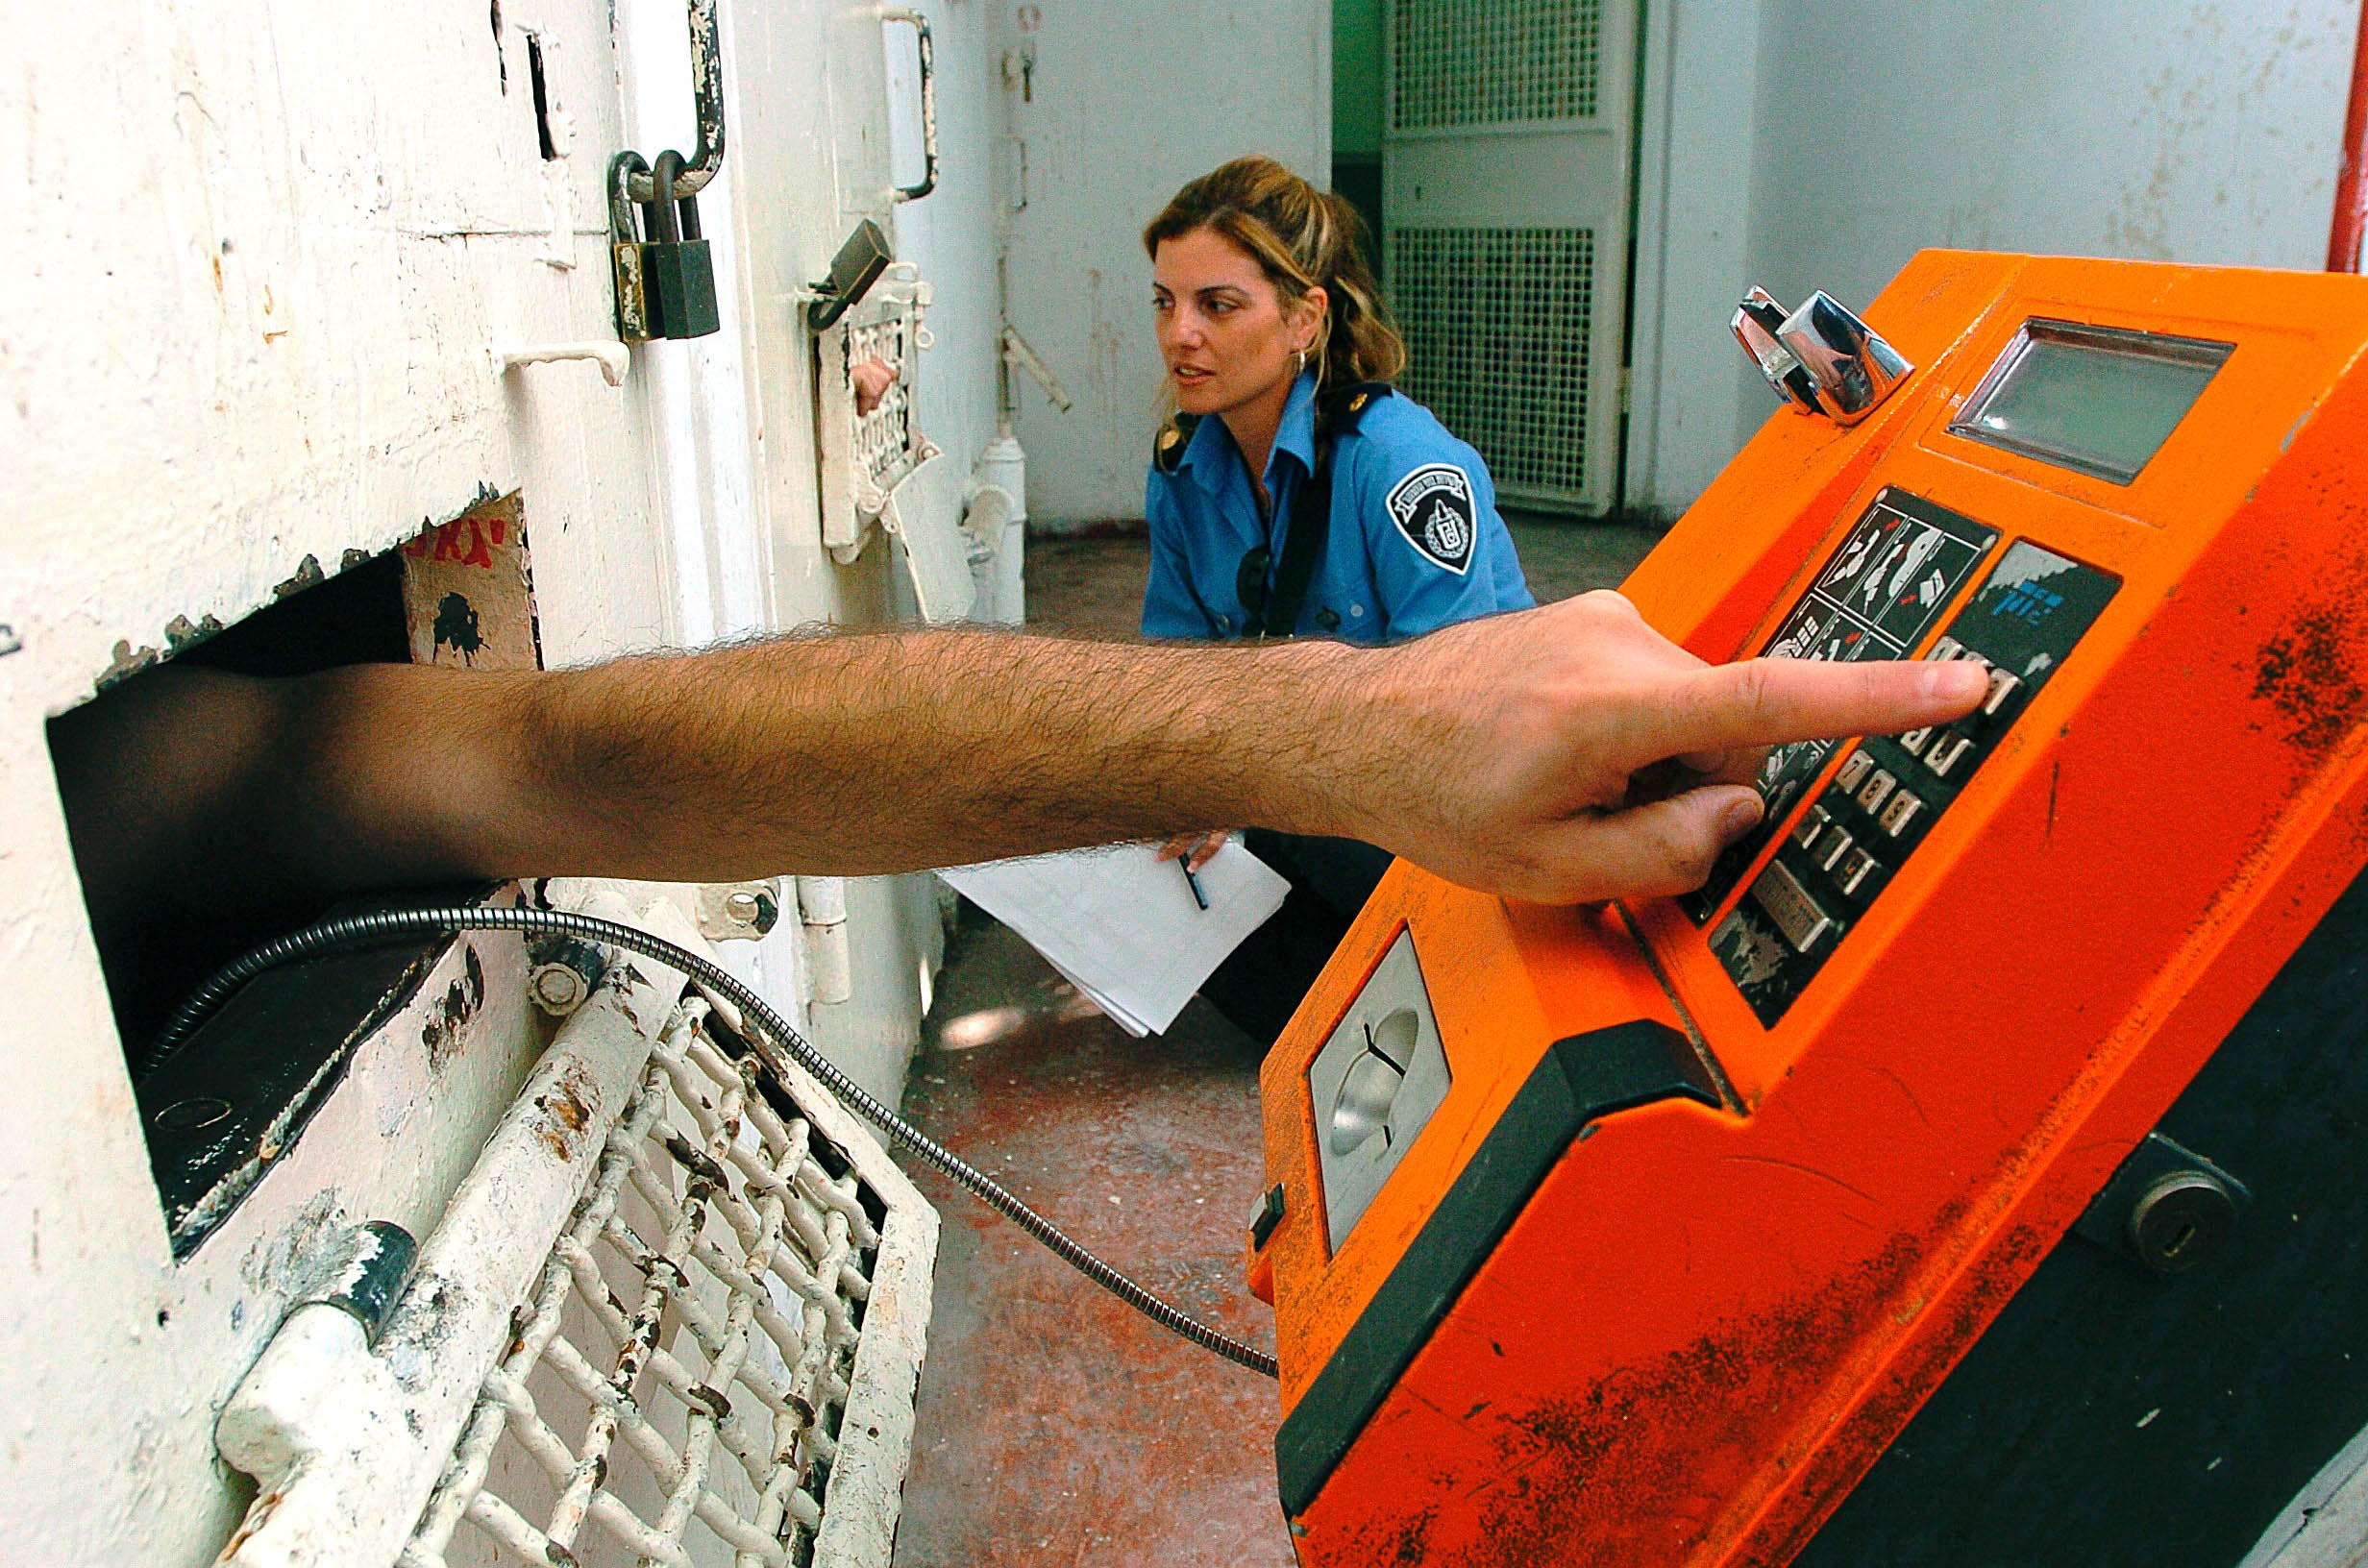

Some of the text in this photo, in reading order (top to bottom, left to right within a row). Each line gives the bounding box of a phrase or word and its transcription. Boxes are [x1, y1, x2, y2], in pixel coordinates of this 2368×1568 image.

[1843, 759, 1860, 779] 7
[1865, 778, 1882, 799] 8
[1887, 799, 1905, 821] 9
